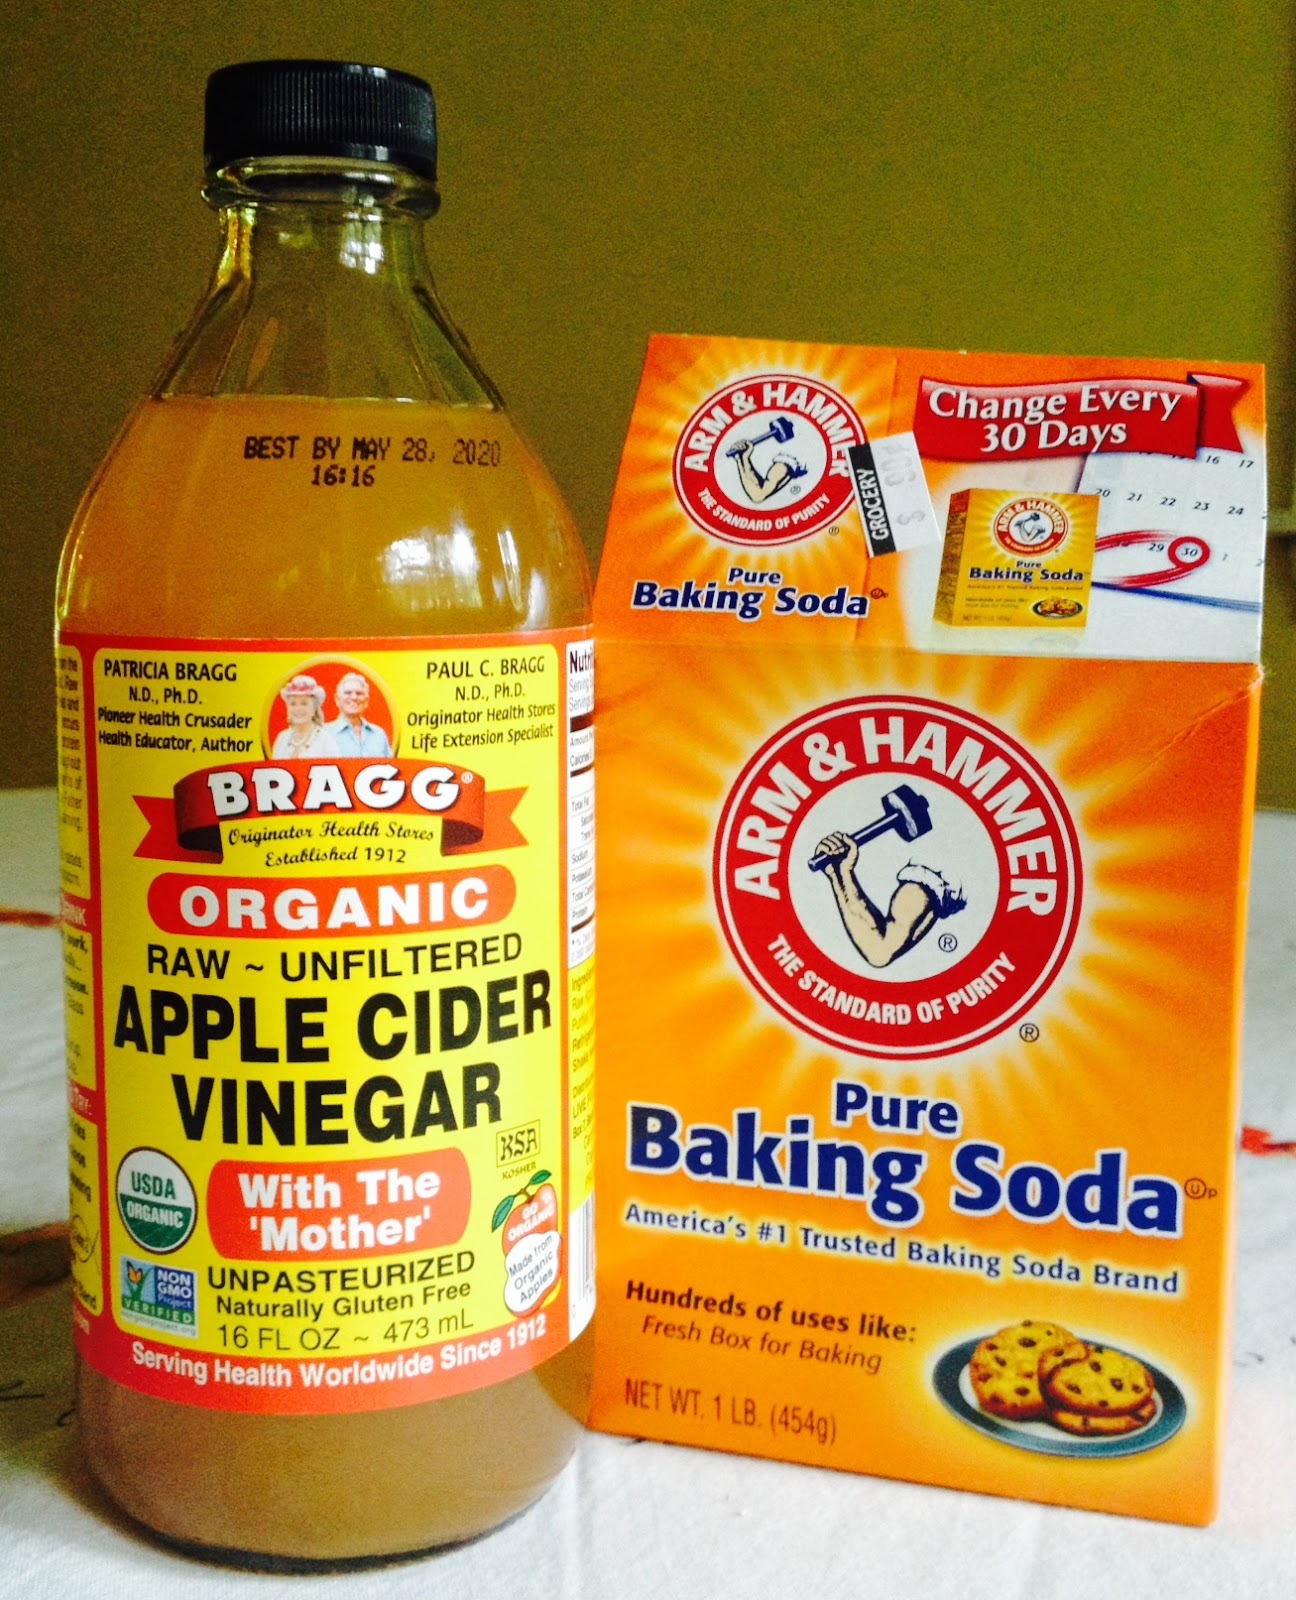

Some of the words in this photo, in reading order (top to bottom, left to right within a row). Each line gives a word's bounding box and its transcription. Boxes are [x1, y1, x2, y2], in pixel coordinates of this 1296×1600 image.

[929, 387, 1067, 426] Change
[1080, 384, 1180, 421] Every
[684, 404, 732, 473] ARM
[730, 390, 757, 416] &
[762, 382, 856, 478] HAMMER
[980, 423, 1026, 452] 30
[1038, 419, 1127, 453] Days
[244, 436, 300, 460] BEST
[312, 436, 341, 460] BY
[352, 437, 391, 461] MAY
[452, 439, 500, 467] 2020
[1205, 455, 1220, 465] 16
[1239, 459, 1254, 468] 17
[312, 464, 376, 487] 16:16
[697, 487, 713, 511] THE
[712, 505, 771, 532] STANDARD
[775, 517, 789, 530] OF
[791, 492, 831, 526] PURITY
[856, 467, 889, 541] GROCERY
[1127, 492, 1143, 502] 21
[1160, 497, 1176, 507] 22
[1193, 501, 1210, 511] 23
[1227, 506, 1244, 516] 24
[1148, 543, 1165, 553] 29
[1180, 547, 1198, 557] 30
[728, 567, 781, 584] Pure
[970, 567, 1033, 583] Baking
[1040, 569, 1084, 581] Soda
[633, 581, 764, 619] Baking
[775, 587, 868, 616] Soda
[104, 659, 169, 680] PATRICIA
[176, 663, 237, 682] BRAGG
[426, 661, 474, 679] PAUL
[480, 660, 494, 676] C.
[500, 656, 545, 675] BRAGG
[129, 687, 159, 705] N.D.,
[164, 687, 202, 705] Ph.D.
[456, 685, 489, 703] N.D.,
[494, 682, 526, 700] Ph.D.
[98, 707, 135, 726] Pioneer
[139, 710, 180, 728] Health
[186, 713, 252, 729] Crusader
[407, 711, 483, 730] Originator
[486, 705, 525, 722] Health
[528, 703, 556, 717] Stores
[98, 730, 132, 748] Health
[135, 733, 196, 752] Educator,
[201, 737, 253, 753] Author
[411, 734, 438, 753] Life
[443, 730, 504, 749] Extension
[507, 723, 554, 746] Specialist
[228, 822, 314, 848] Originator
[319, 820, 380, 839] Health
[385, 822, 434, 841] Stores
[735, 761, 812, 900] ARM
[802, 732, 857, 782] &
[859, 716, 1058, 917] HAMMER
[265, 846, 358, 867] Established
[365, 848, 406, 864] 1912
[179, 876, 489, 931] ORGANIC
[147, 943, 230, 980] RAW
[281, 932, 522, 982] UNFILTERED
[767, 933, 800, 976] THE
[798, 969, 911, 1026] STANDARD
[917, 998, 945, 1024] OF
[946, 951, 1017, 1015] PURITY
[114, 984, 330, 1063] APPLE
[357, 969, 552, 1061] CIDER
[171, 1061, 502, 1147] VINEGAR
[836, 1082, 958, 1135] Pure
[500, 1128, 538, 1161] KSA
[131, 1170, 176, 1200] USDA
[502, 1161, 536, 1180] KOSHER
[630, 1105, 922, 1223] Baking
[954, 1144, 1178, 1233] Soda
[238, 1172, 341, 1210] With
[357, 1168, 441, 1205] The
[127, 1204, 184, 1229] ORGANIC
[522, 1202, 538, 1219] GO
[250, 1205, 430, 1252] 'Mother'
[508, 1253, 533, 1278] Made
[534, 1235, 553, 1257] from
[626, 1204, 746, 1238] America's
[757, 1223, 786, 1243] #1
[800, 1227, 896, 1258] Trusted
[908, 1241, 1000, 1277] Baking
[1013, 1254, 1080, 1282] Soda
[1094, 1266, 1178, 1293] Brand
[158, 1269, 191, 1286] NON
[208, 1250, 475, 1293] UNPASTEURIZED
[514, 1250, 554, 1290] Organic
[520, 1268, 554, 1304] Apples
[157, 1281, 192, 1299] GMO
[217, 1295, 322, 1322] Naturally
[333, 1292, 420, 1317] Gluten
[423, 1282, 471, 1304] Free
[123, 1297, 192, 1324] VERIFIED
[626, 1280, 746, 1318] Hundreds
[756, 1301, 782, 1323] of
[791, 1311, 849, 1333] uses
[859, 1314, 916, 1343] like:
[218, 1324, 248, 1349] 16
[259, 1328, 290, 1350] FL
[300, 1328, 340, 1351] OZ
[384, 1317, 430, 1343] 473
[438, 1308, 474, 1335] mL
[642, 1315, 701, 1342] Fresh
[710, 1329, 751, 1349] Box
[759, 1331, 791, 1356] for
[799, 1339, 882, 1375] Baking
[132, 1341, 207, 1385] Serving
[215, 1359, 292, 1387] Health
[300, 1352, 434, 1388] Worldwide
[440, 1334, 502, 1370] Since
[507, 1313, 546, 1349] 1912
[625, 1378, 662, 1411] NET
[669, 1387, 703, 1418] WT.
[714, 1396, 721, 1418] 1
[731, 1399, 763, 1428] LB.
[770, 1404, 836, 1445] (454g)
